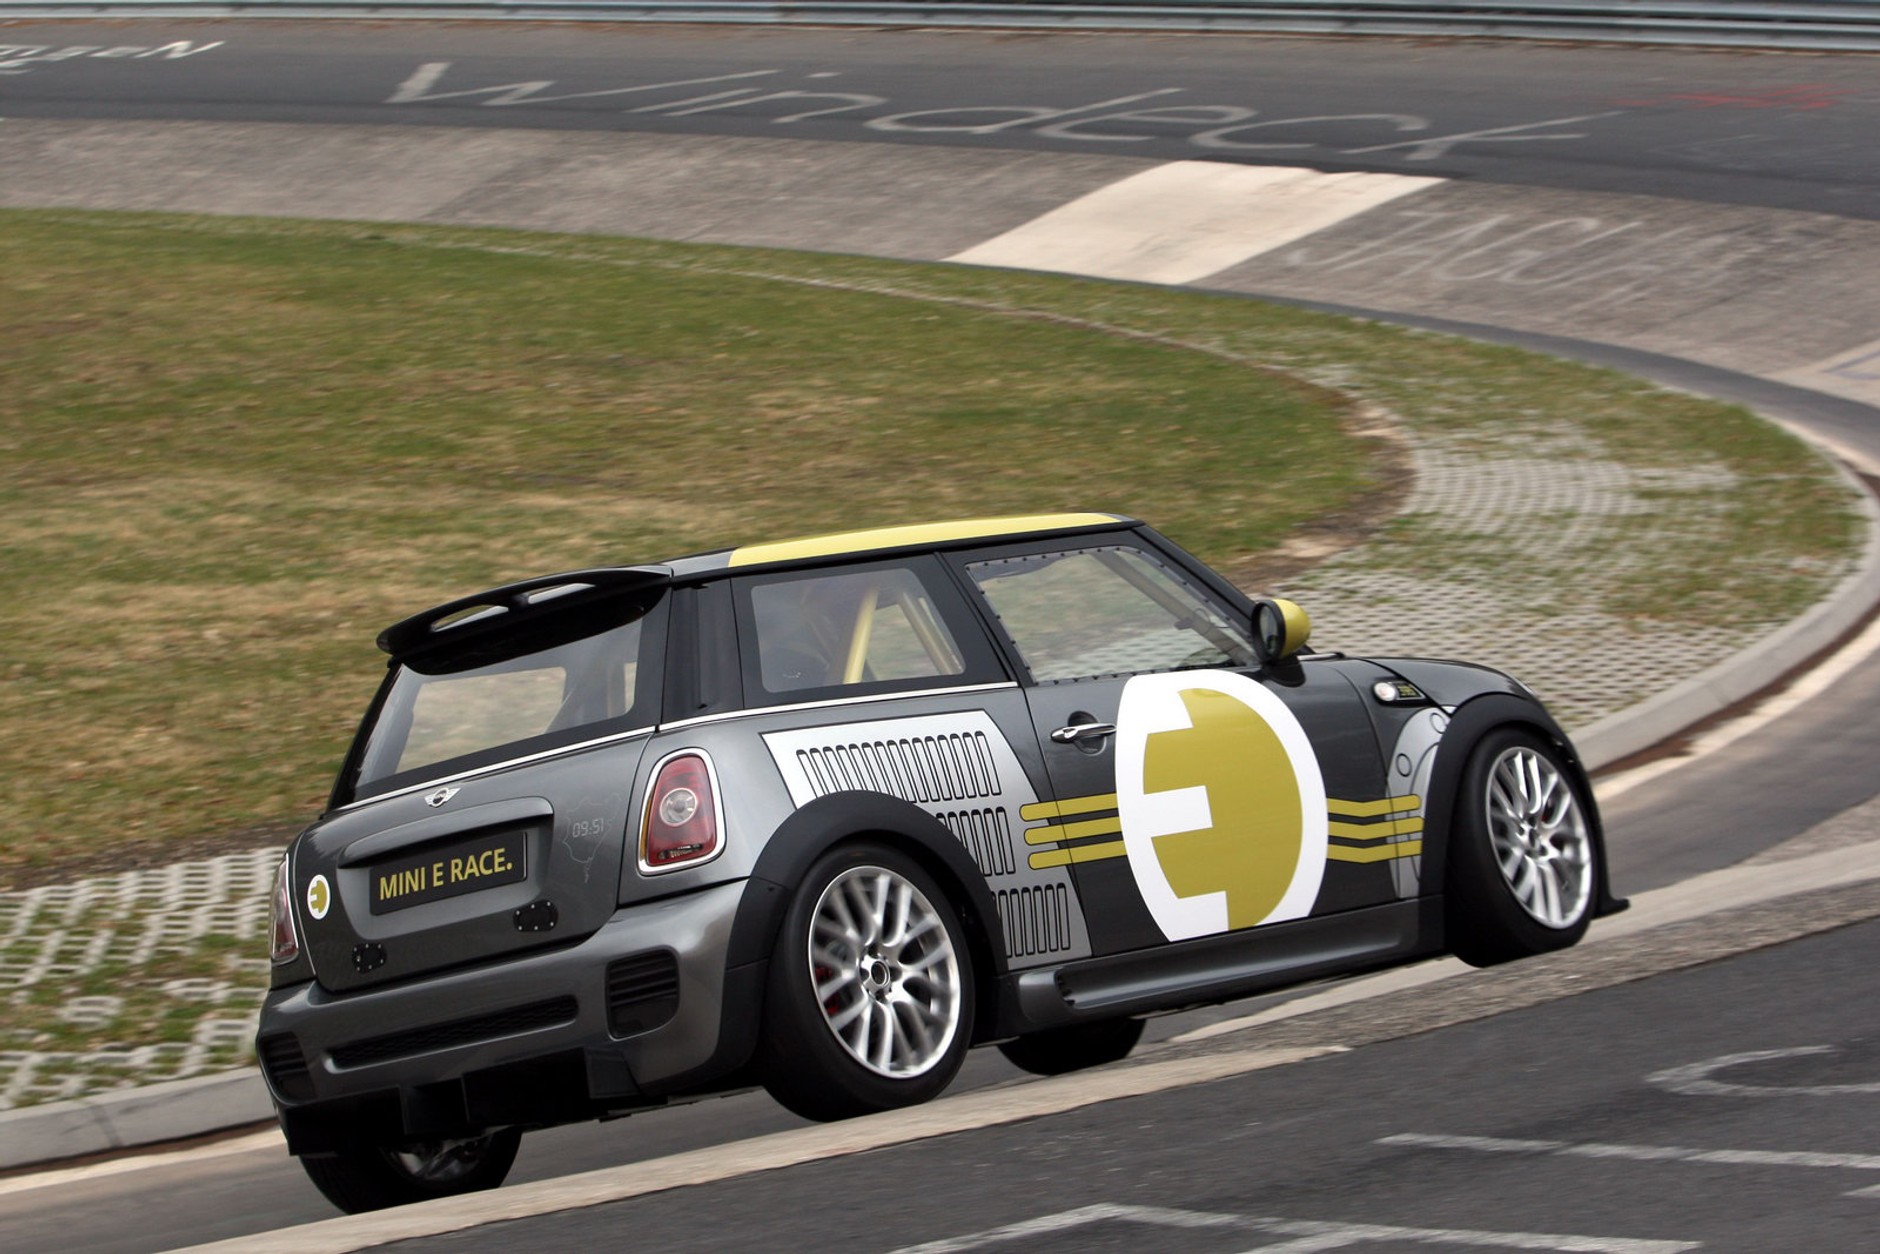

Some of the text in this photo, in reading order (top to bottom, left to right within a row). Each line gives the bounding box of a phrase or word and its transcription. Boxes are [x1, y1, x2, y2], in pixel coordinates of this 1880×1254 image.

[385, 62, 1623, 160] Windeck
[572, 817, 605, 838] 09:51
[380, 847, 513, 901] MINI E RACE.
